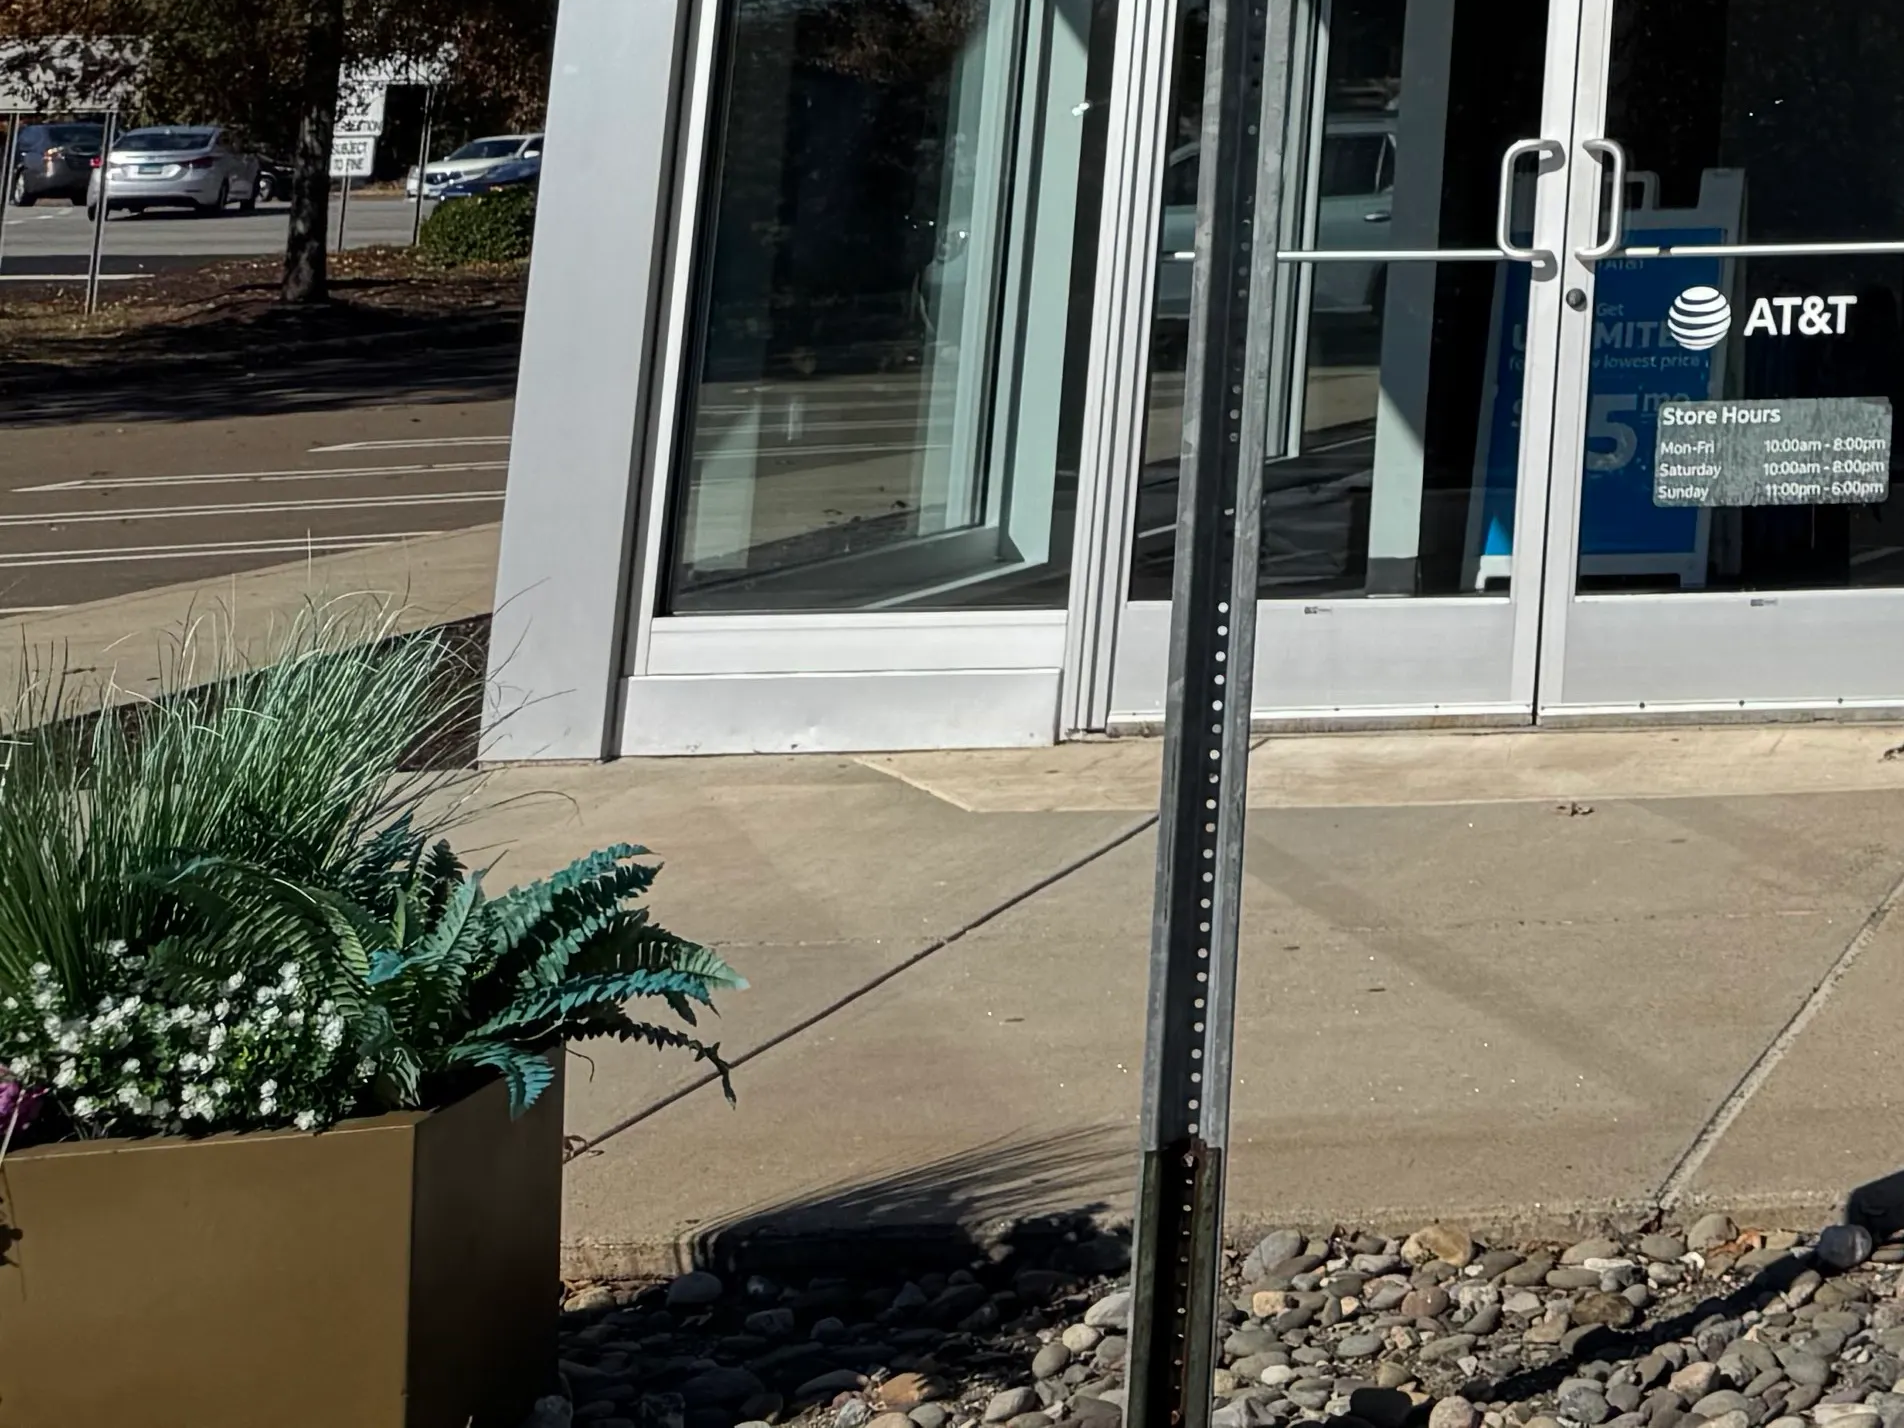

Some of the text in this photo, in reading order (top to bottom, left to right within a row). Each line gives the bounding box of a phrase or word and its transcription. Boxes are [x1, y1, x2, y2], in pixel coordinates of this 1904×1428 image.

[1743, 296, 1857, 337] AT&T
[1604, 354, 1656, 369] lowest
[1662, 405, 1781, 426] Store Hours
[1660, 440, 1715, 455] Mon-Fri
[1764, 439, 1821, 452] 10:00am
[1833, 438, 1886, 454] 8:00pm
[1659, 463, 1722, 479] Saturday
[1763, 462, 1820, 475] 10:00am
[1832, 461, 1885, 477] 8:00pm
[1658, 485, 1709, 501] Sunday
[1765, 484, 1820, 498] 11:00pm
[1831, 482, 1884, 498] 6:00pm
